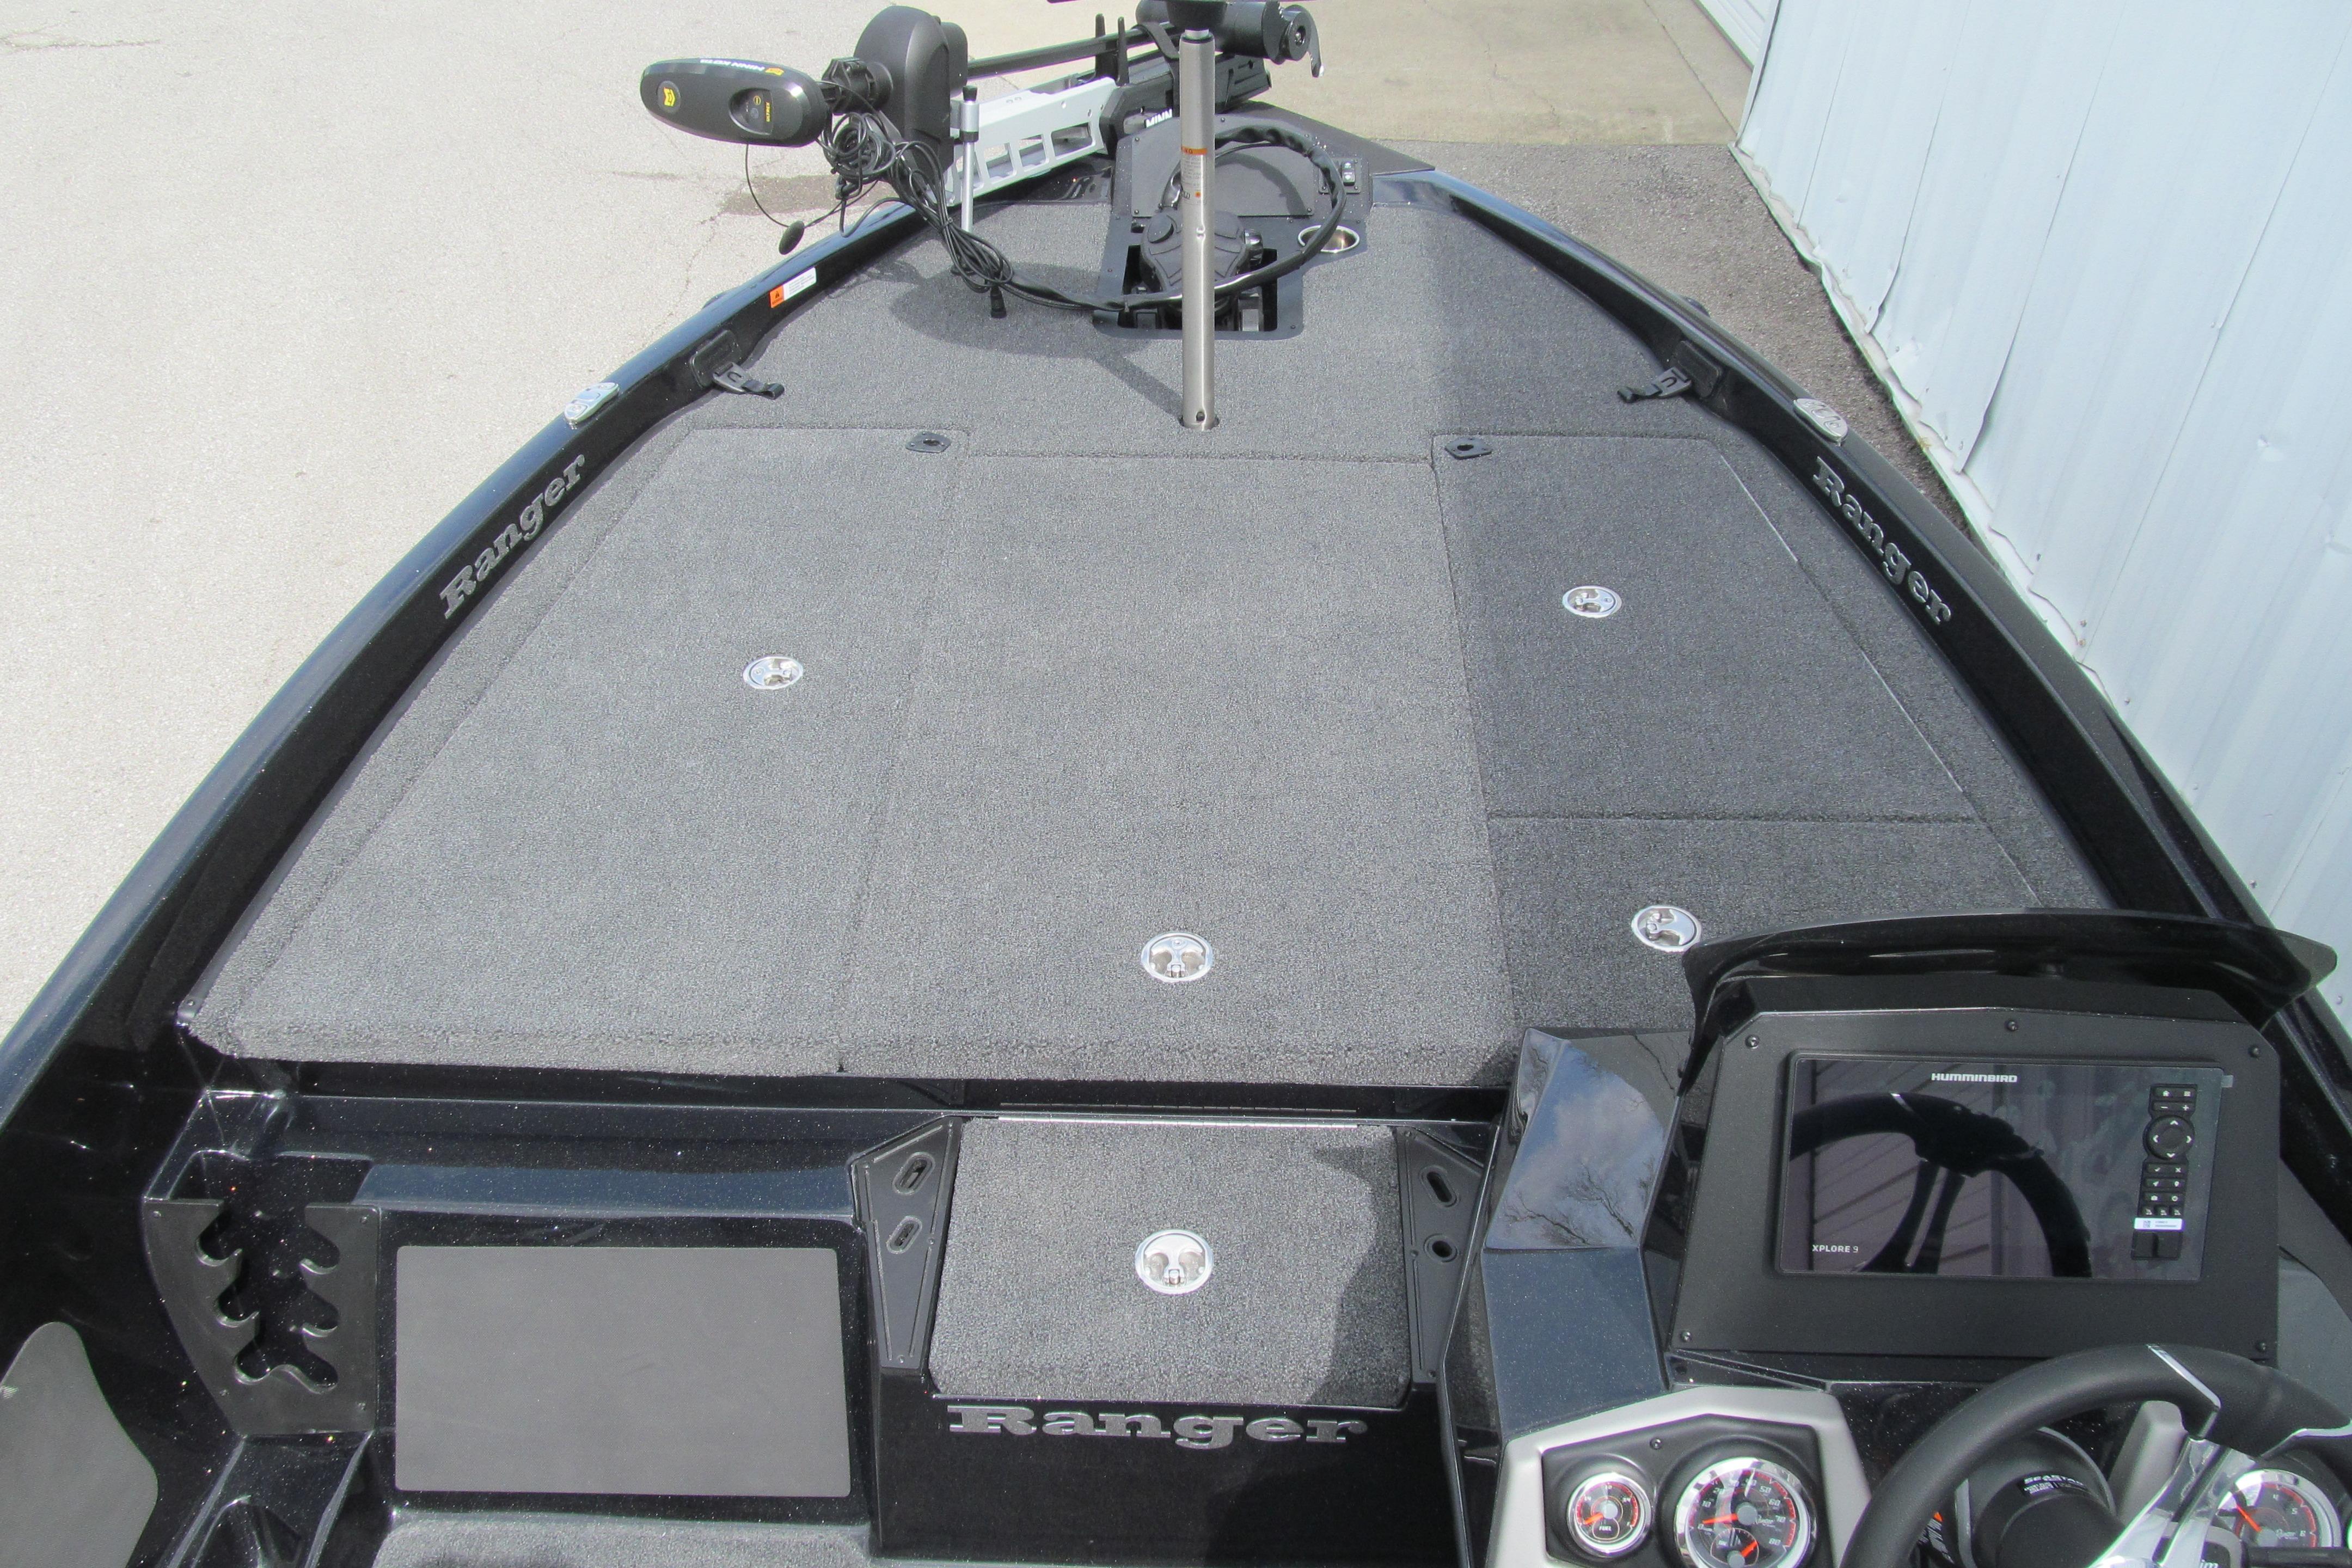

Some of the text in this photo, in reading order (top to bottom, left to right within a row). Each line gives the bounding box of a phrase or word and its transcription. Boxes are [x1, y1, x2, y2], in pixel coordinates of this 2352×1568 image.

[1146, 108, 1172, 127] MINN
[439, 454, 585, 619] Ranger
[1813, 456, 1951, 624] Ranger
[1931, 1073, 2018, 1083] HUMMINBIRD
[1812, 1245, 1851, 1253] XPLORE
[947, 1404, 1368, 1450] Ranger
[1759, 1485, 1772, 1493] 50
[1769, 1498, 1781, 1507] 60
[1775, 1515, 1786, 1523] 70
